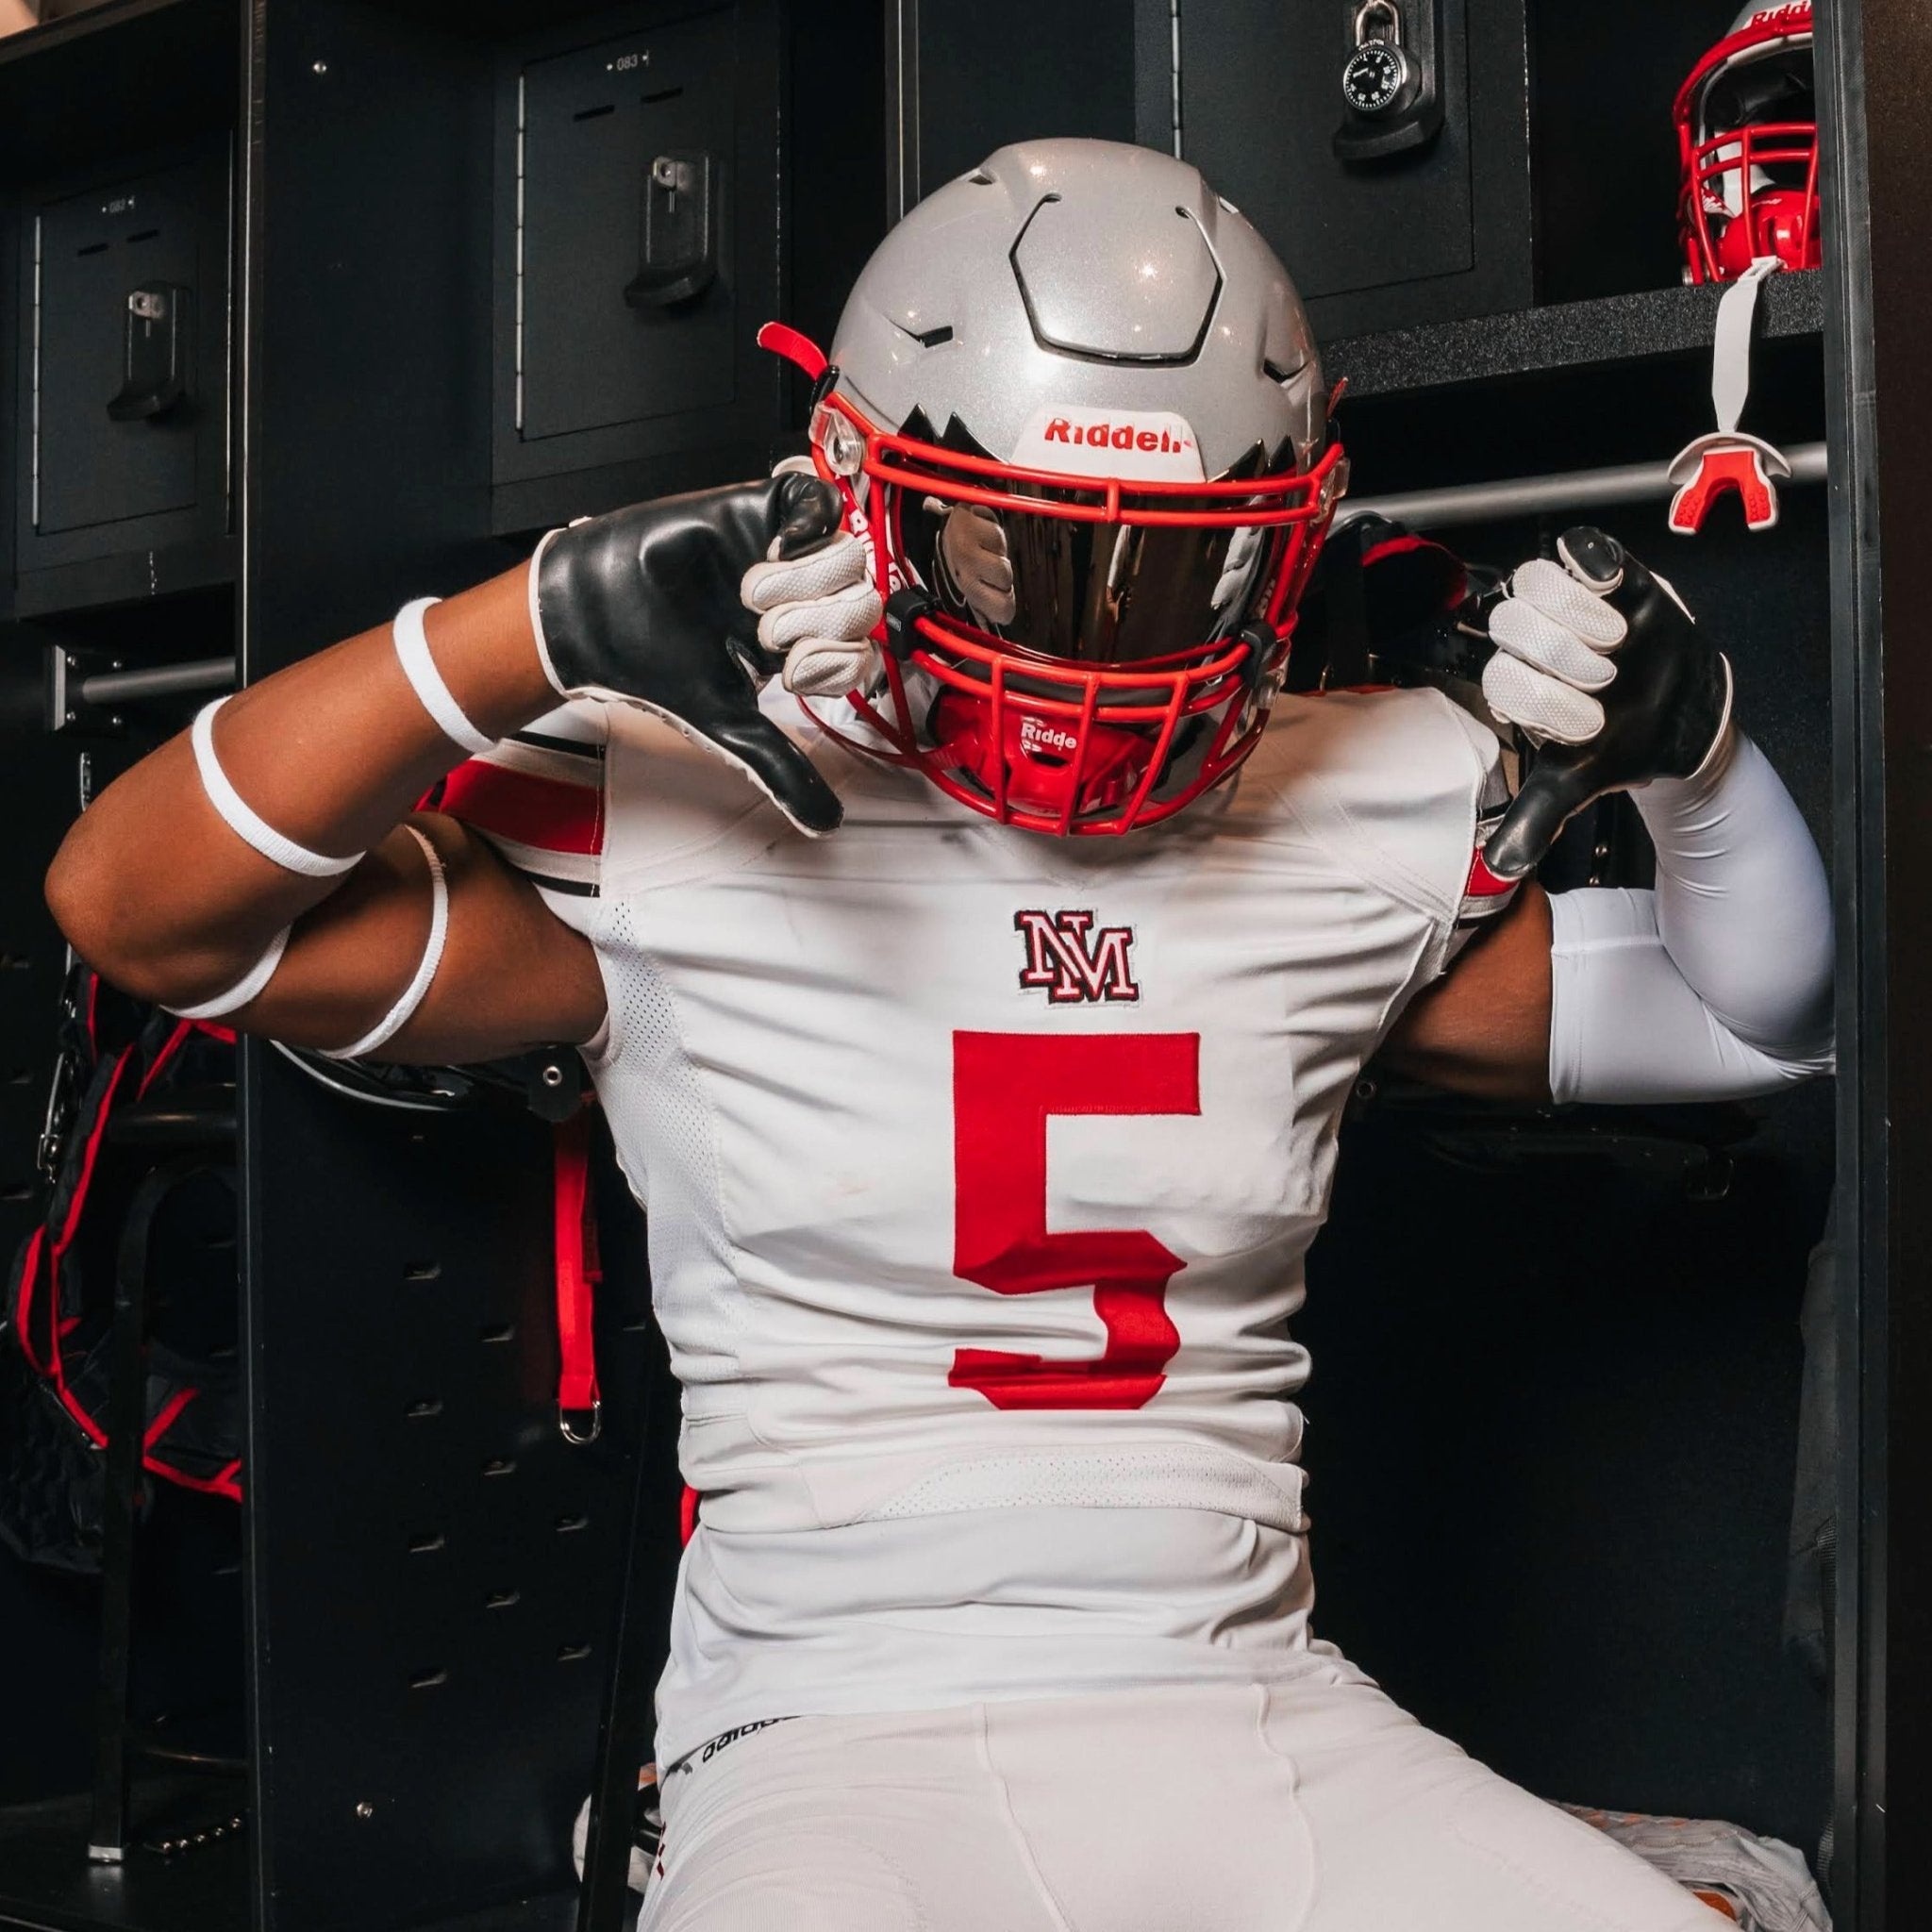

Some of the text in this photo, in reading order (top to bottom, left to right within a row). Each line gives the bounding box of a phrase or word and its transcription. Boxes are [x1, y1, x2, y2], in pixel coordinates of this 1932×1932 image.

[616, 54, 639, 72] 083
[1013, 910, 1140, 1005] NM
[948, 1030, 1202, 1410] 5
